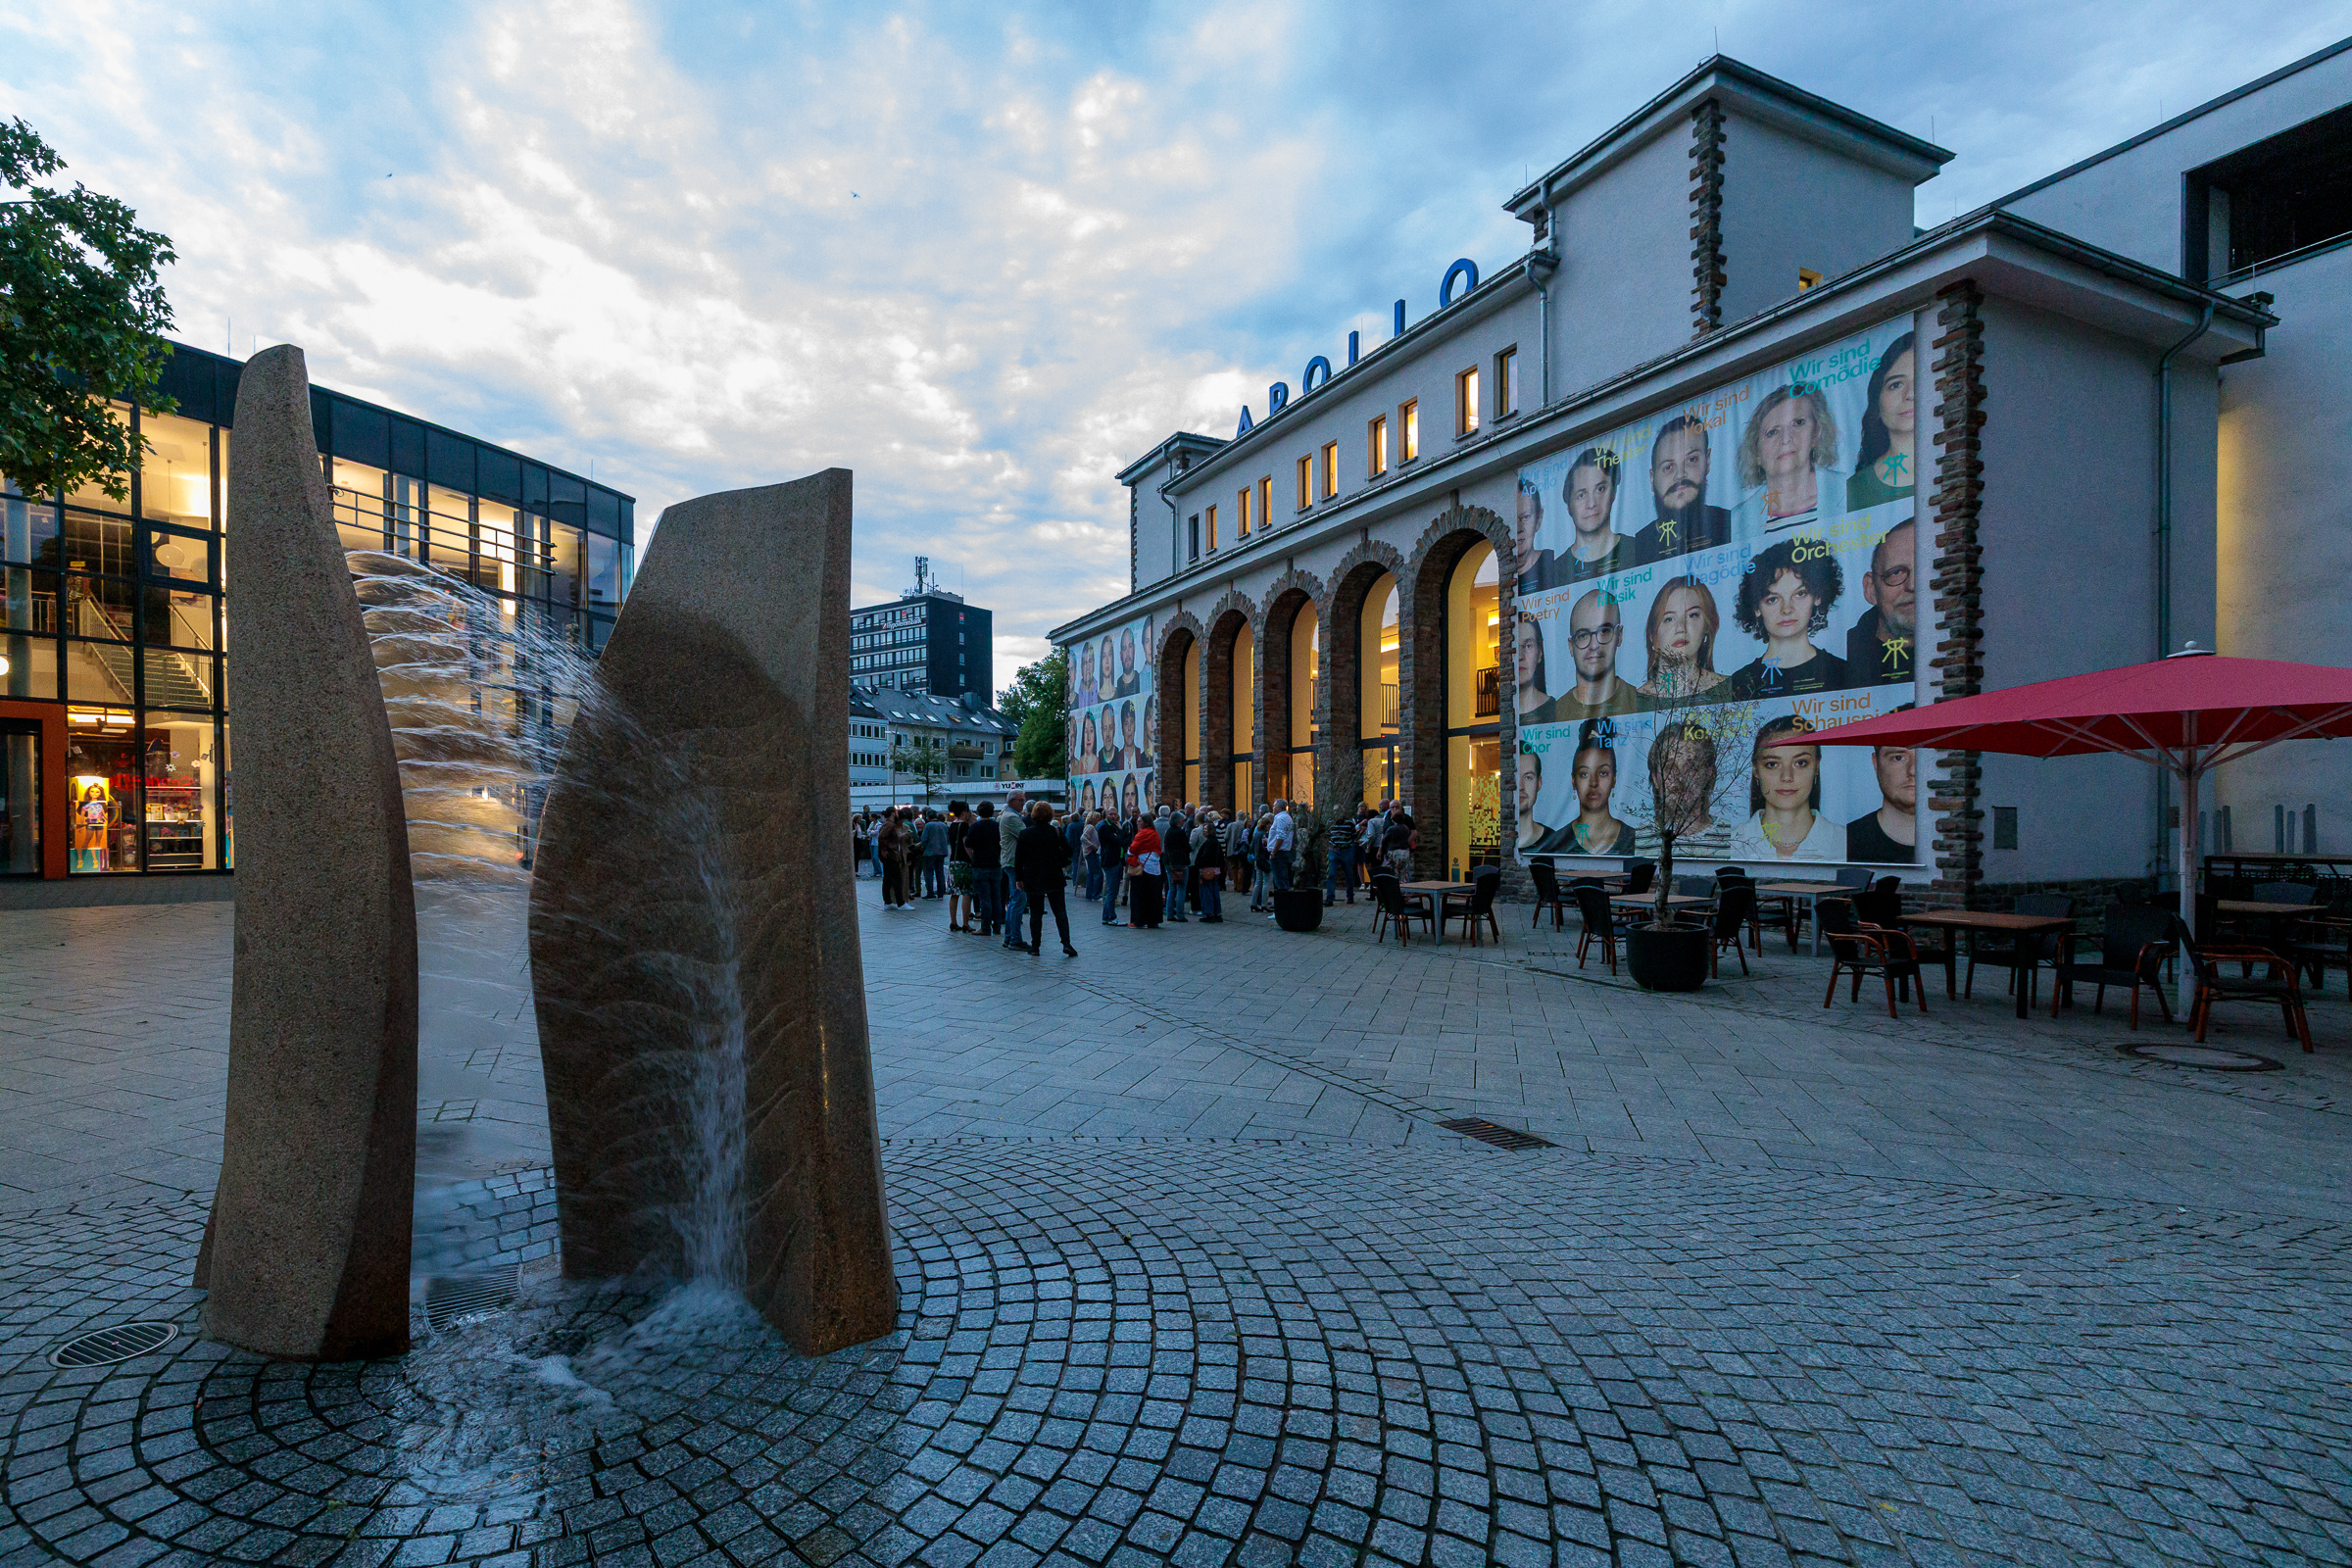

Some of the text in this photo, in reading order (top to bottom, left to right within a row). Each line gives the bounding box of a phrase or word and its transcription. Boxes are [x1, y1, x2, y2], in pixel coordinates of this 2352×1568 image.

[1789, 338, 1871, 382] Wir sind
[1788, 357, 1882, 399] Comödie
[1683, 385, 1749, 422] Wir sind
[1683, 411, 1726, 437] Vokal
[1594, 424, 1651, 457] Wir sind
[1593, 443, 1648, 470] Theater
[1518, 457, 1568, 484] Wir sind
[1520, 477, 1557, 498] Apollo
[1791, 513, 1871, 547] Wir sind
[1684, 543, 1751, 572] Wir sind
[1791, 530, 1890, 564] Orchester
[1596, 567, 1652, 593] Wir sind
[1684, 560, 1756, 587] Tragödie
[1521, 588, 1570, 611] Wir sind
[1597, 587, 1637, 608] Musik
[1521, 608, 1560, 623] Poetry
[1791, 692, 1871, 715] Wir sind
[1522, 725, 1571, 741] Wir sind
[1596, 716, 1653, 734] Wir sind
[1791, 708, 1898, 732] Schaus
[1522, 741, 1551, 754] Chor
[1597, 734, 1627, 749] Tanz
